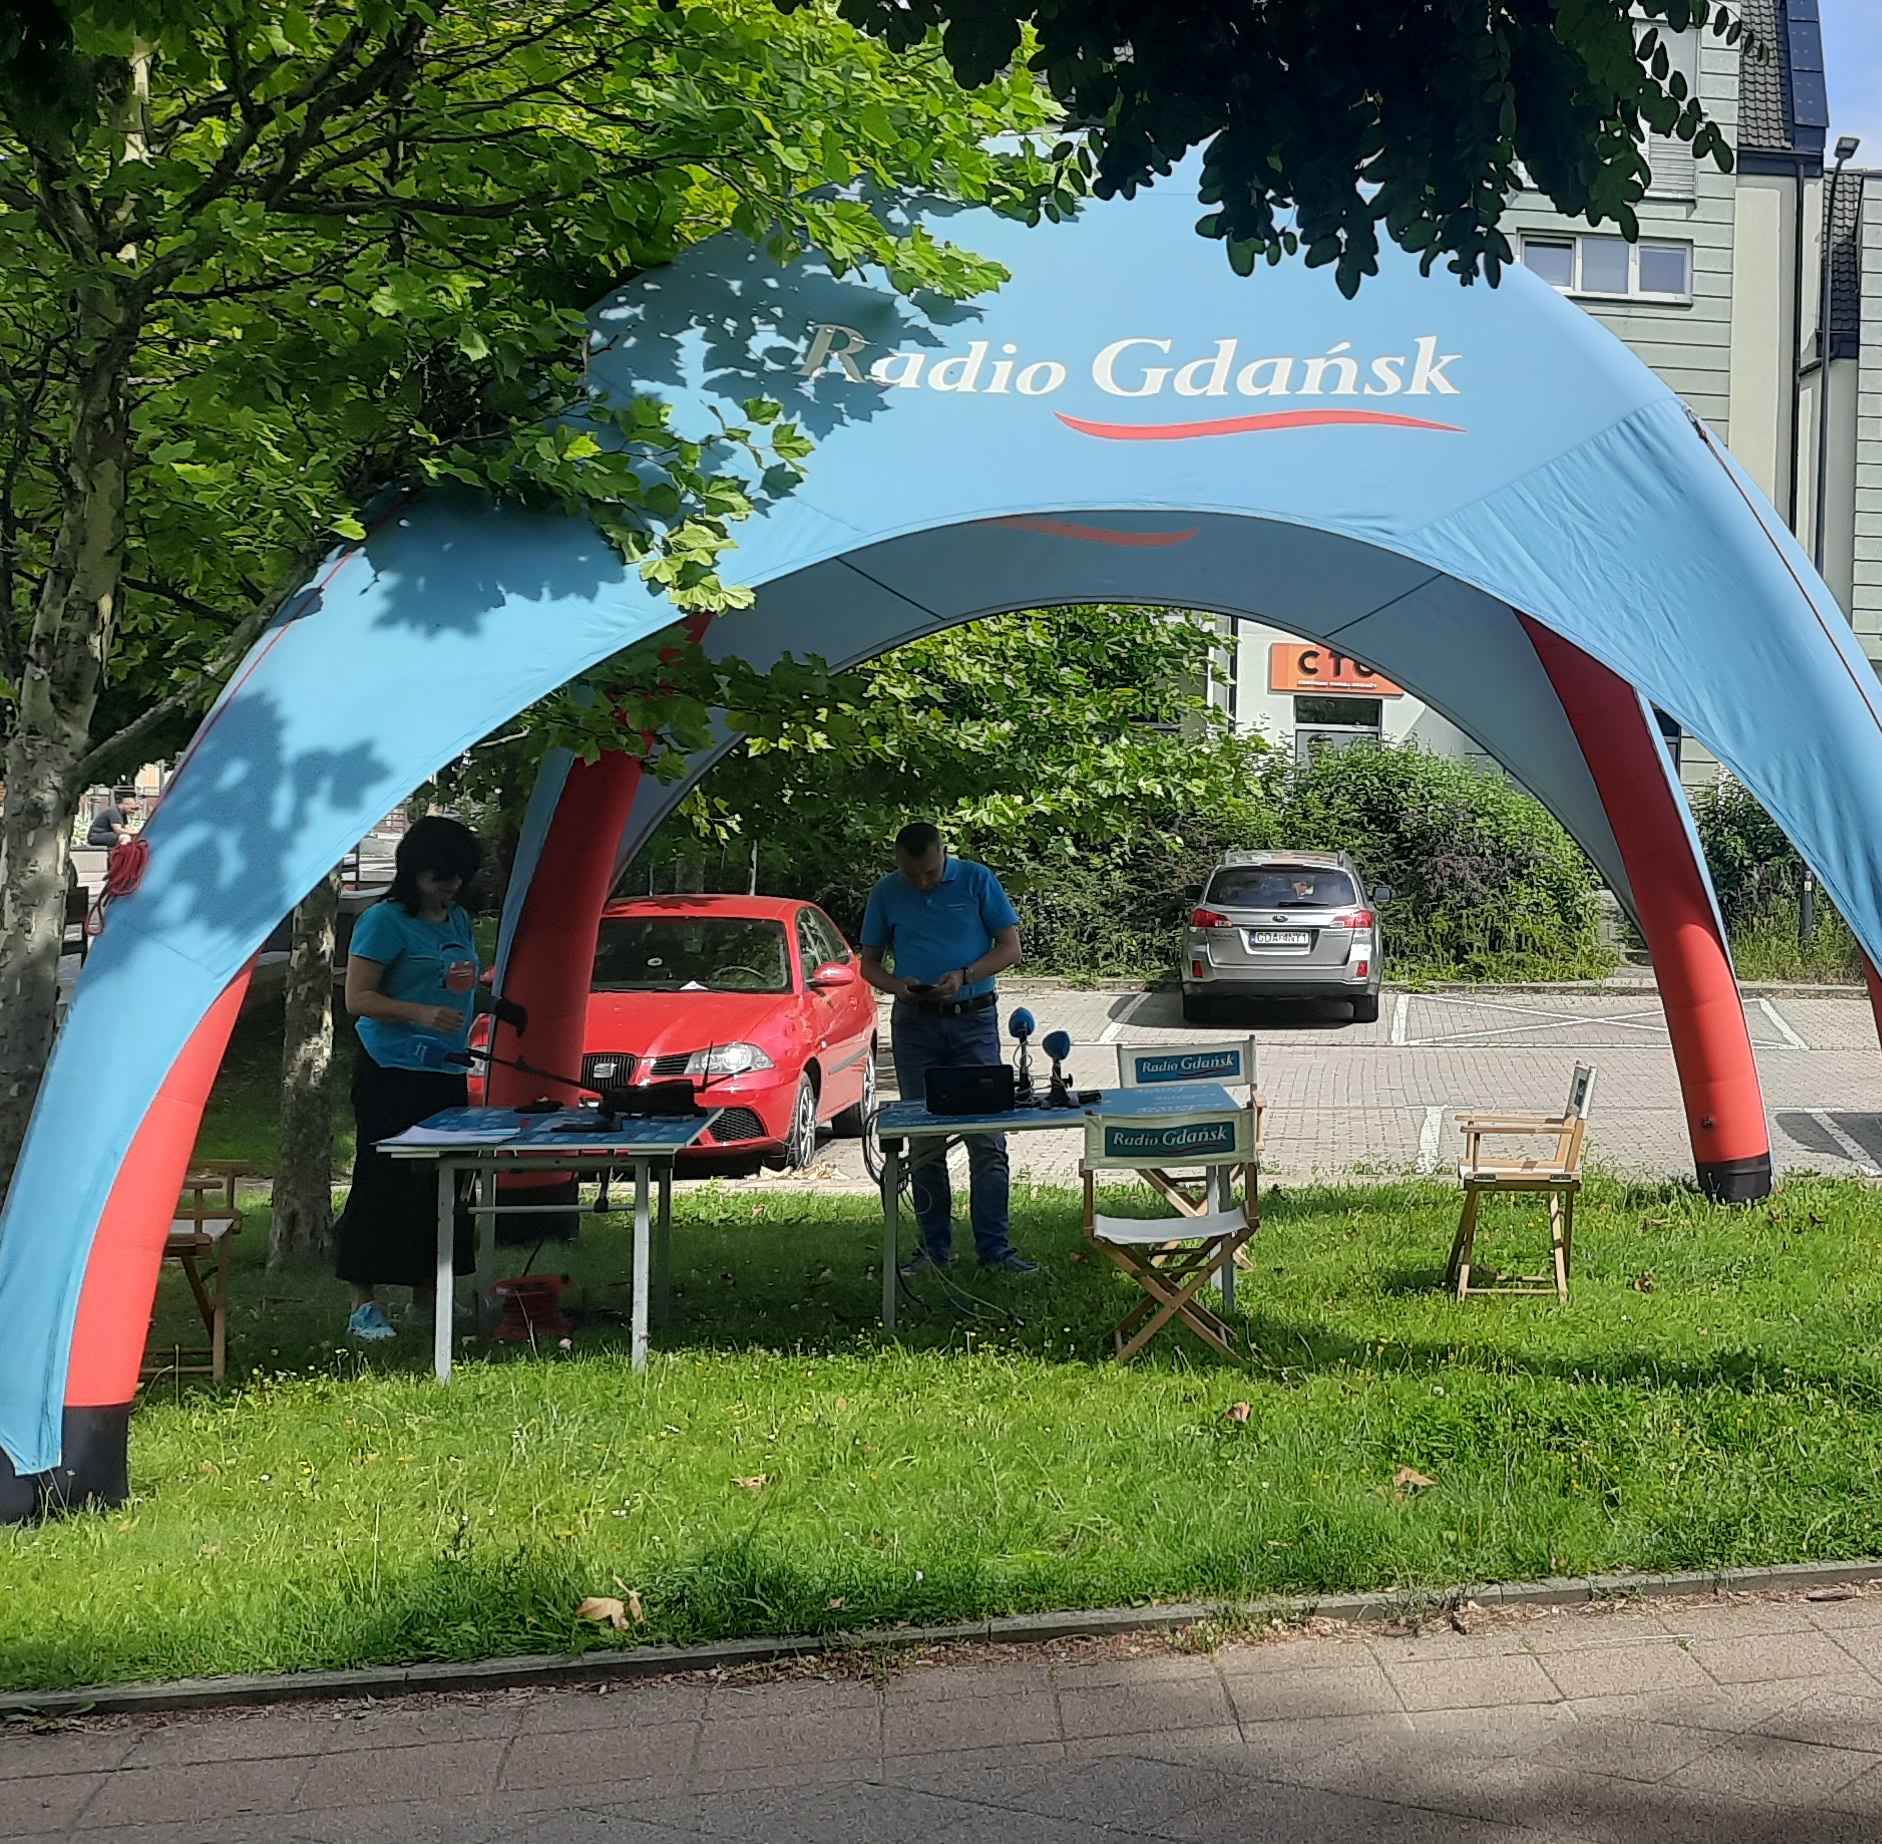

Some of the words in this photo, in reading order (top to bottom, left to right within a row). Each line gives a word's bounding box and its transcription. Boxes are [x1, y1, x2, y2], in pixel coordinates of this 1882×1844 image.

[793, 322, 1067, 396] Radio
[1092, 335, 1463, 397] Gdańsk
[1141, 1060, 1179, 1073] Radio
[1180, 1054, 1234, 1071] Gdańsk
[1113, 1132, 1159, 1146] Radio
[1162, 1125, 1228, 1146] Gdańsk
